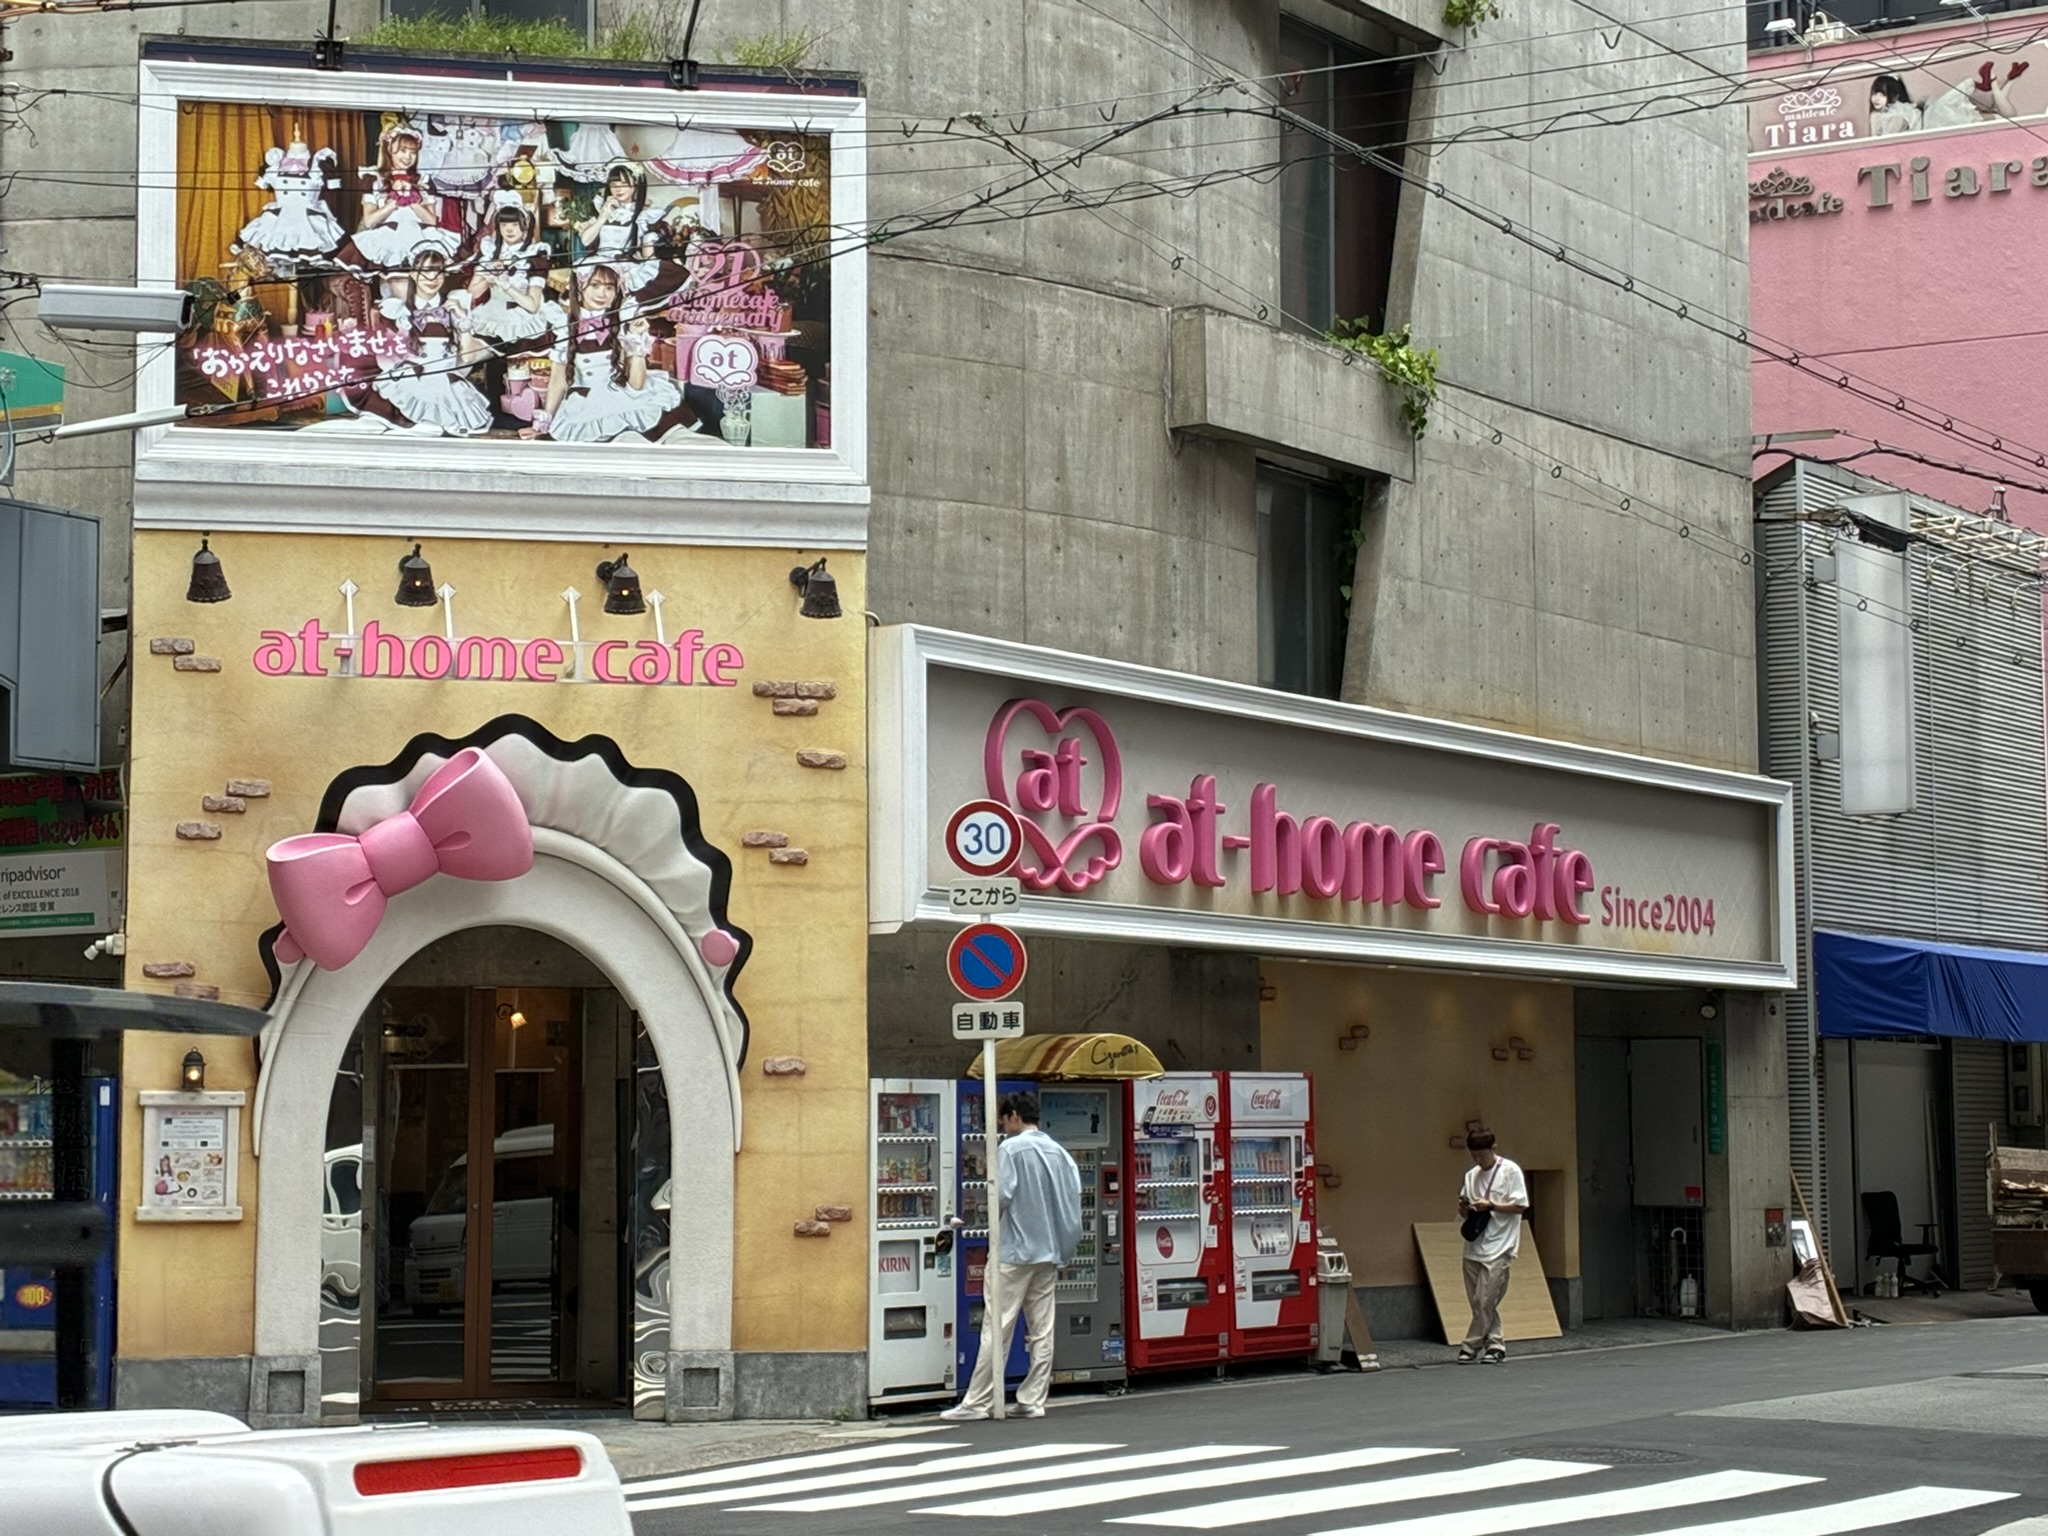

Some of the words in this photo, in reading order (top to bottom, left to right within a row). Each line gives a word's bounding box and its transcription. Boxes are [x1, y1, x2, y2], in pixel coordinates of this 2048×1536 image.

[1765, 120, 1855, 148] Tiara
[1749, 192, 1844, 222] aidcafe
[697, 247, 746, 292] 21
[710, 350, 739, 369] at
[252, 618, 564, 682] at-home
[592, 629, 744, 686] cafe
[1015, 737, 1088, 817] at
[963, 822, 1006, 856] 30
[1139, 774, 1446, 909] at-home
[1460, 822, 1595, 925] cafe
[0, 865, 61, 887] ripadvisor
[12, 887, 60, 900] EXCELLENCE
[61, 886, 80, 898] 2018
[952, 886, 1018, 907] ここから
[0, 901, 38, 914] レンス認証
[1601, 886, 1716, 937] Since2004
[957, 1011, 1020, 1032] 自動車
[878, 1256, 911, 1273] KIRIN
